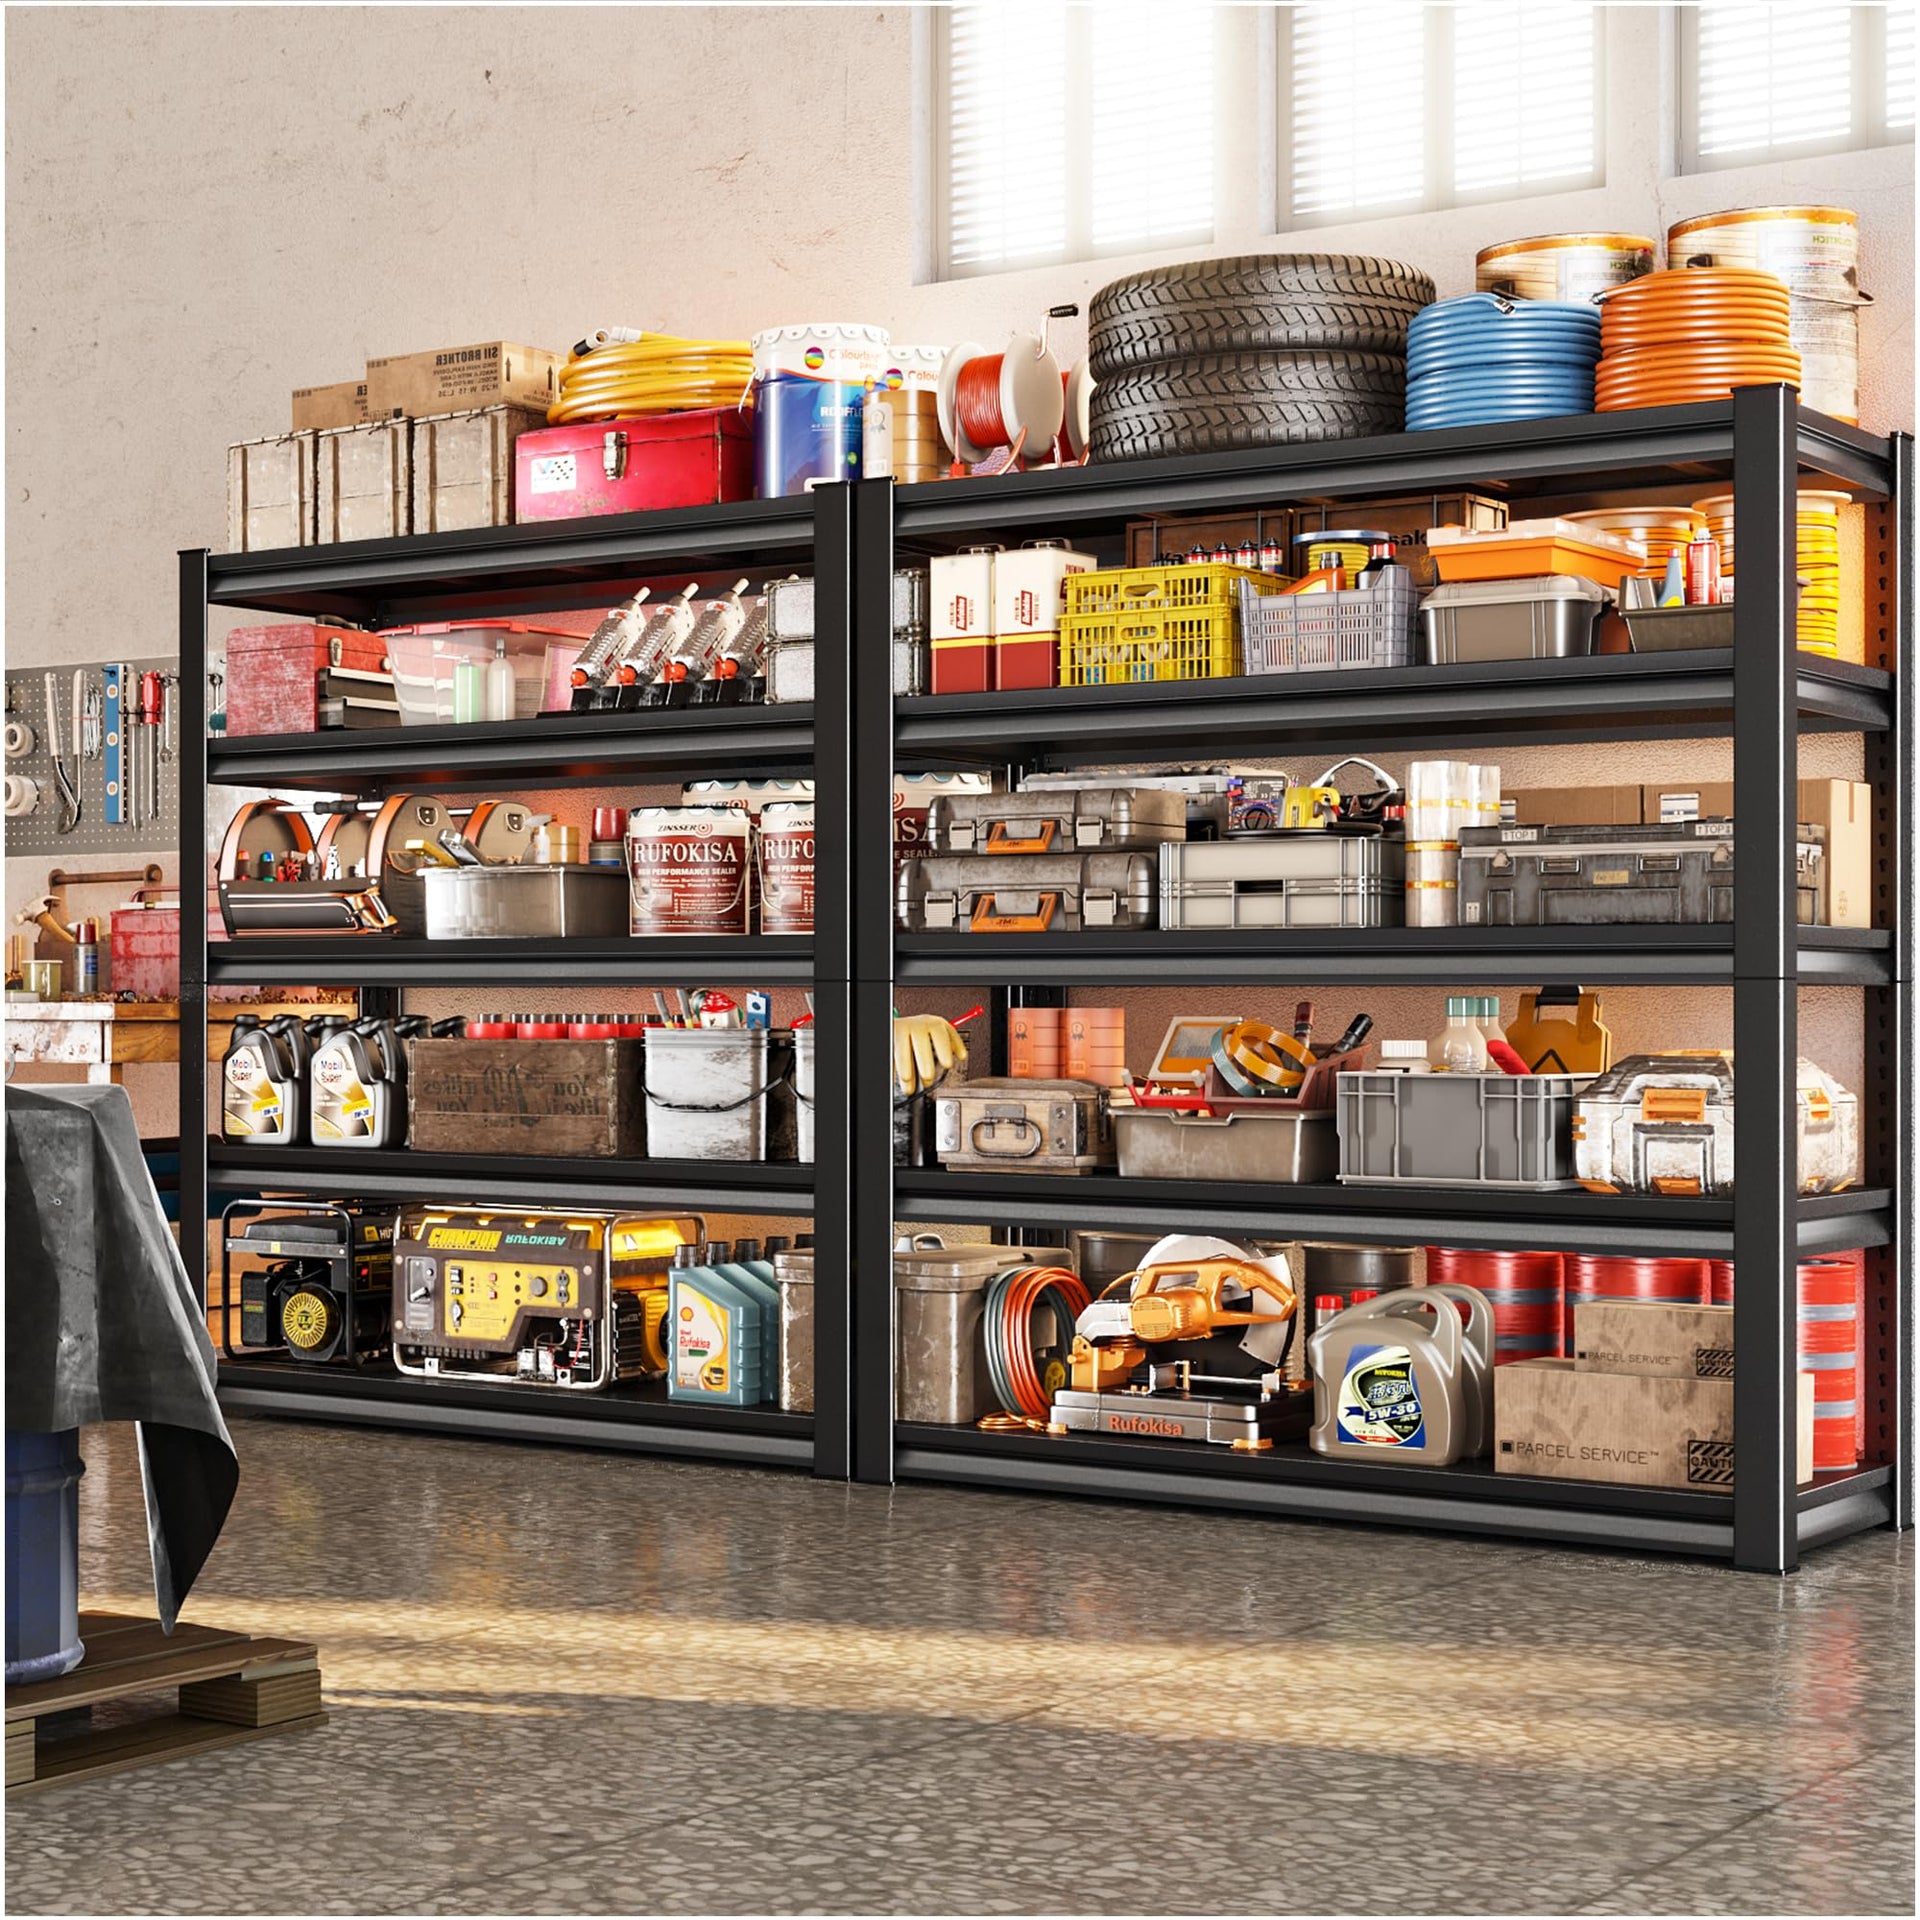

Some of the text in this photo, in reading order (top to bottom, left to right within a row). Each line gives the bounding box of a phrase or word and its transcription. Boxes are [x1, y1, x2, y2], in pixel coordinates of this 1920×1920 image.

[657, 823, 698, 832] ZINSSER
[786, 820, 815, 828] ZINSS
[1706, 824, 1725, 834] TOP
[1511, 830, 1529, 840] TOP
[633, 841, 739, 864] RUFOKISA
[763, 838, 815, 860] RUFO
[903, 849, 941, 859] SEALE
[652, 866, 710, 877] PERFORMANCE
[711, 867, 737, 876] SEALER
[429, 1227, 502, 1244] CHAMPION
[1588, 1351, 1626, 1363] PARCEL
[1368, 1403, 1417, 1421] 5W-30
[1109, 1414, 1184, 1436] Rufokisa
[1516, 1441, 1576, 1459] PARCEL
[1690, 1456, 1735, 1470] CAUTI
